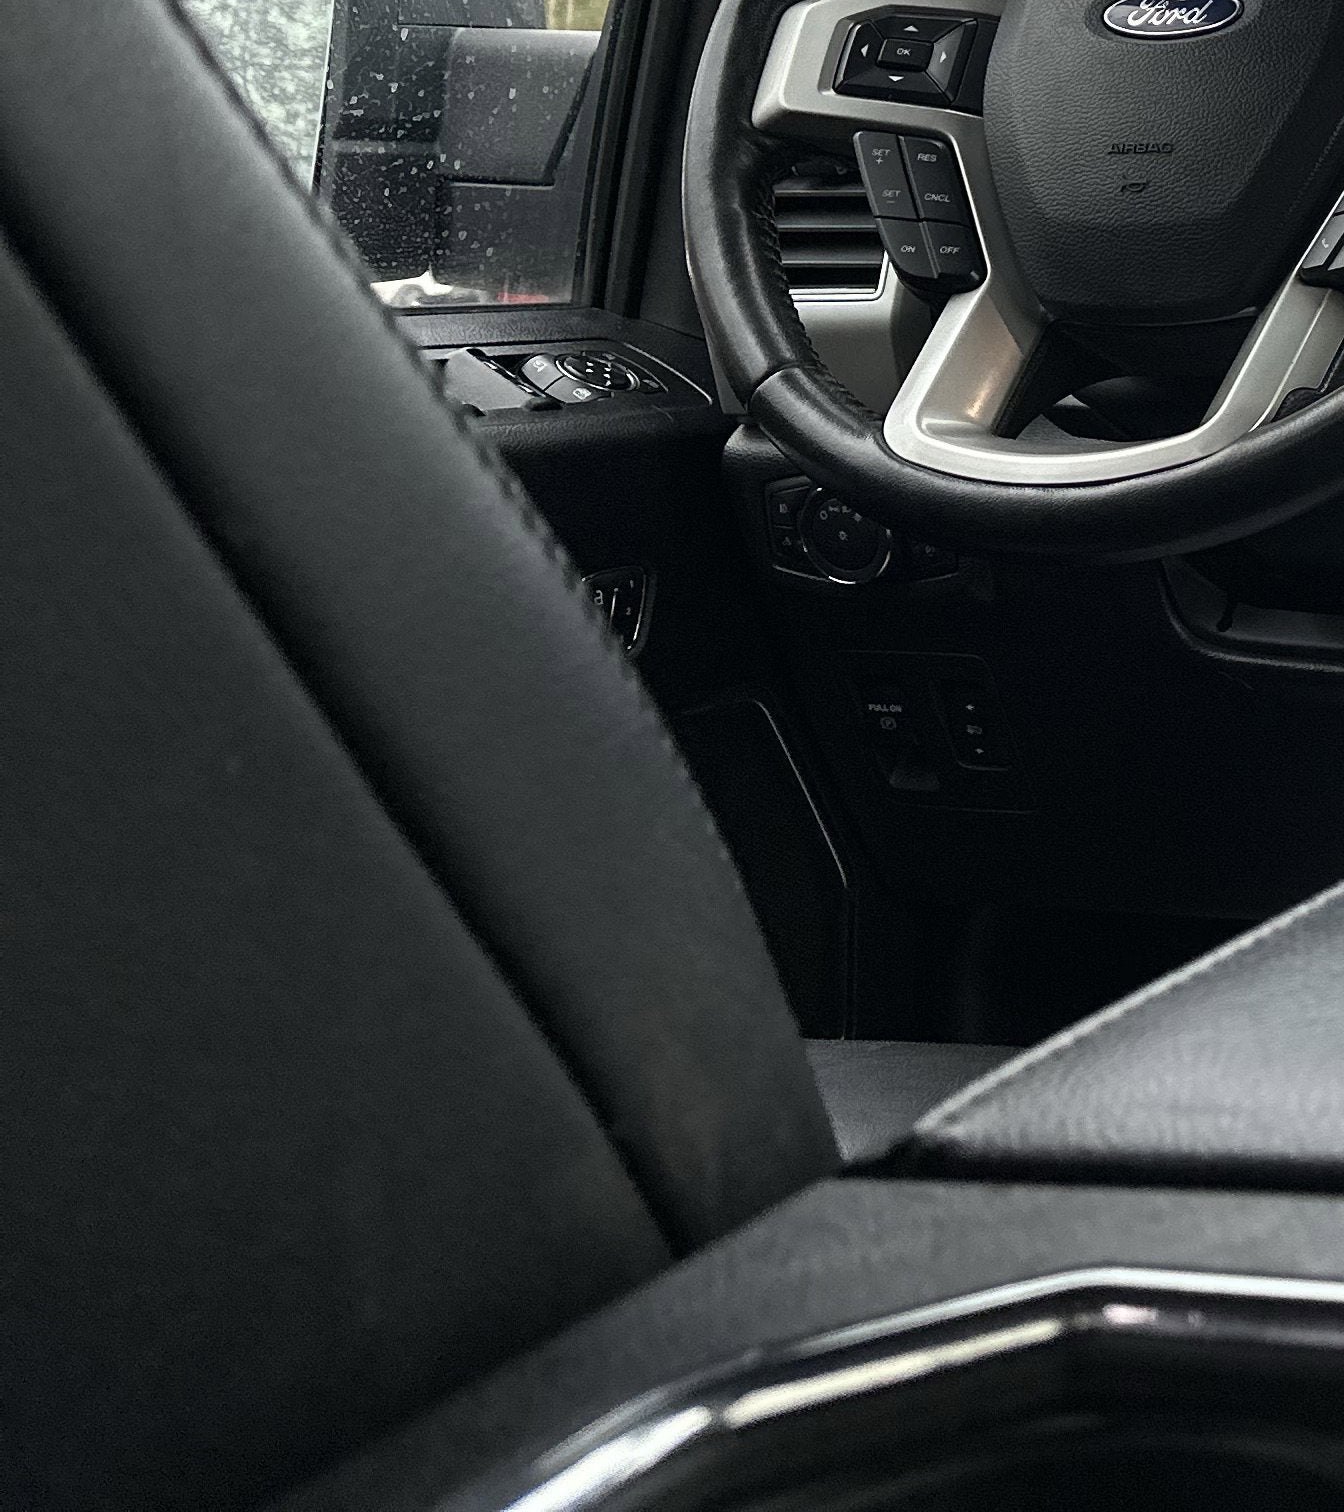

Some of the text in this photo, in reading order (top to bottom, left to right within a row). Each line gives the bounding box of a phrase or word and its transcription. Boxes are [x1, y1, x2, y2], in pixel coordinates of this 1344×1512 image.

[896, 47, 911, 57] OK
[871, 148, 891, 157] SET
[917, 153, 938, 163] RES
[881, 190, 901, 198] SET
[924, 193, 951, 203] CNCL
[900, 245, 916, 254] ON
[939, 246, 961, 255] OFF
